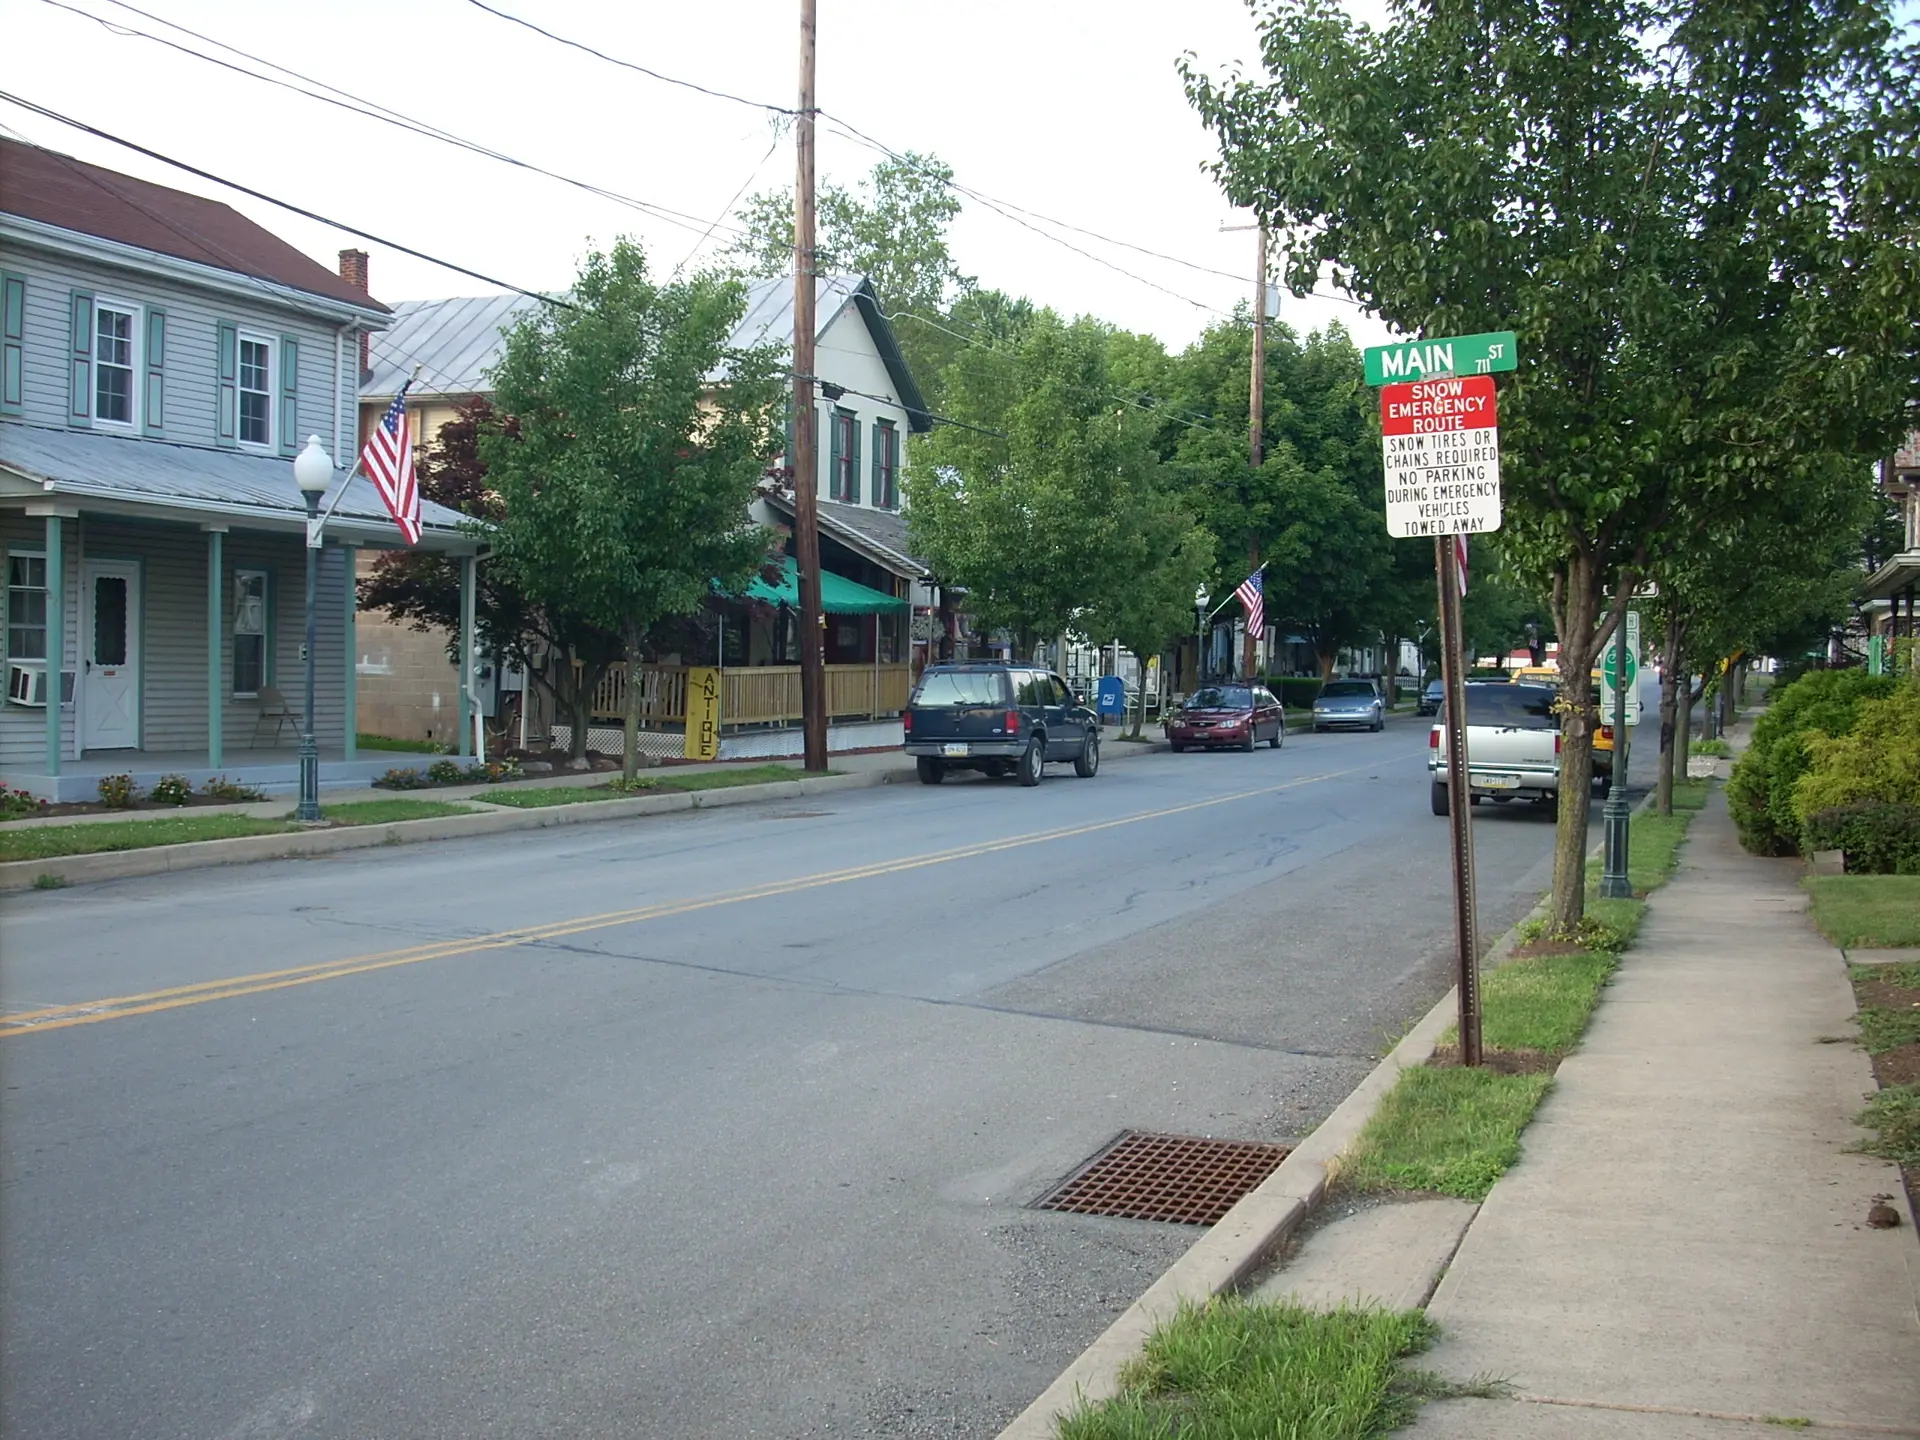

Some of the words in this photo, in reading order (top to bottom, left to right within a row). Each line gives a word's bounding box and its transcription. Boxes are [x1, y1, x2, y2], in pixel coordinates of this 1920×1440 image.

[1381, 343, 1454, 378] MAIN
[1488, 344, 1504, 360] ST
[1411, 381, 1463, 399] SNOW
[1389, 395, 1486, 419] EMERGENCY
[1413, 415, 1465, 433] ROUTE
[1390, 436, 1425, 453] SNOW
[1432, 432, 1466, 449] TIRES
[1474, 431, 1491, 445] OR
[1386, 452, 1429, 469] CHAINS
[1436, 447, 1496, 465] REQUIRED
[1400, 471, 1418, 486] NO
[1426, 466, 1485, 483] PARKING
[1388, 487, 1428, 503] DURING
[1433, 482, 1497, 500] EMERGENCY
[1418, 501, 1470, 518] VEHICLES
[1405, 520, 1445, 536] TOWED
[1453, 517, 1484, 532] AWAY
[701, 673, 715, 756] ANTIQUE
